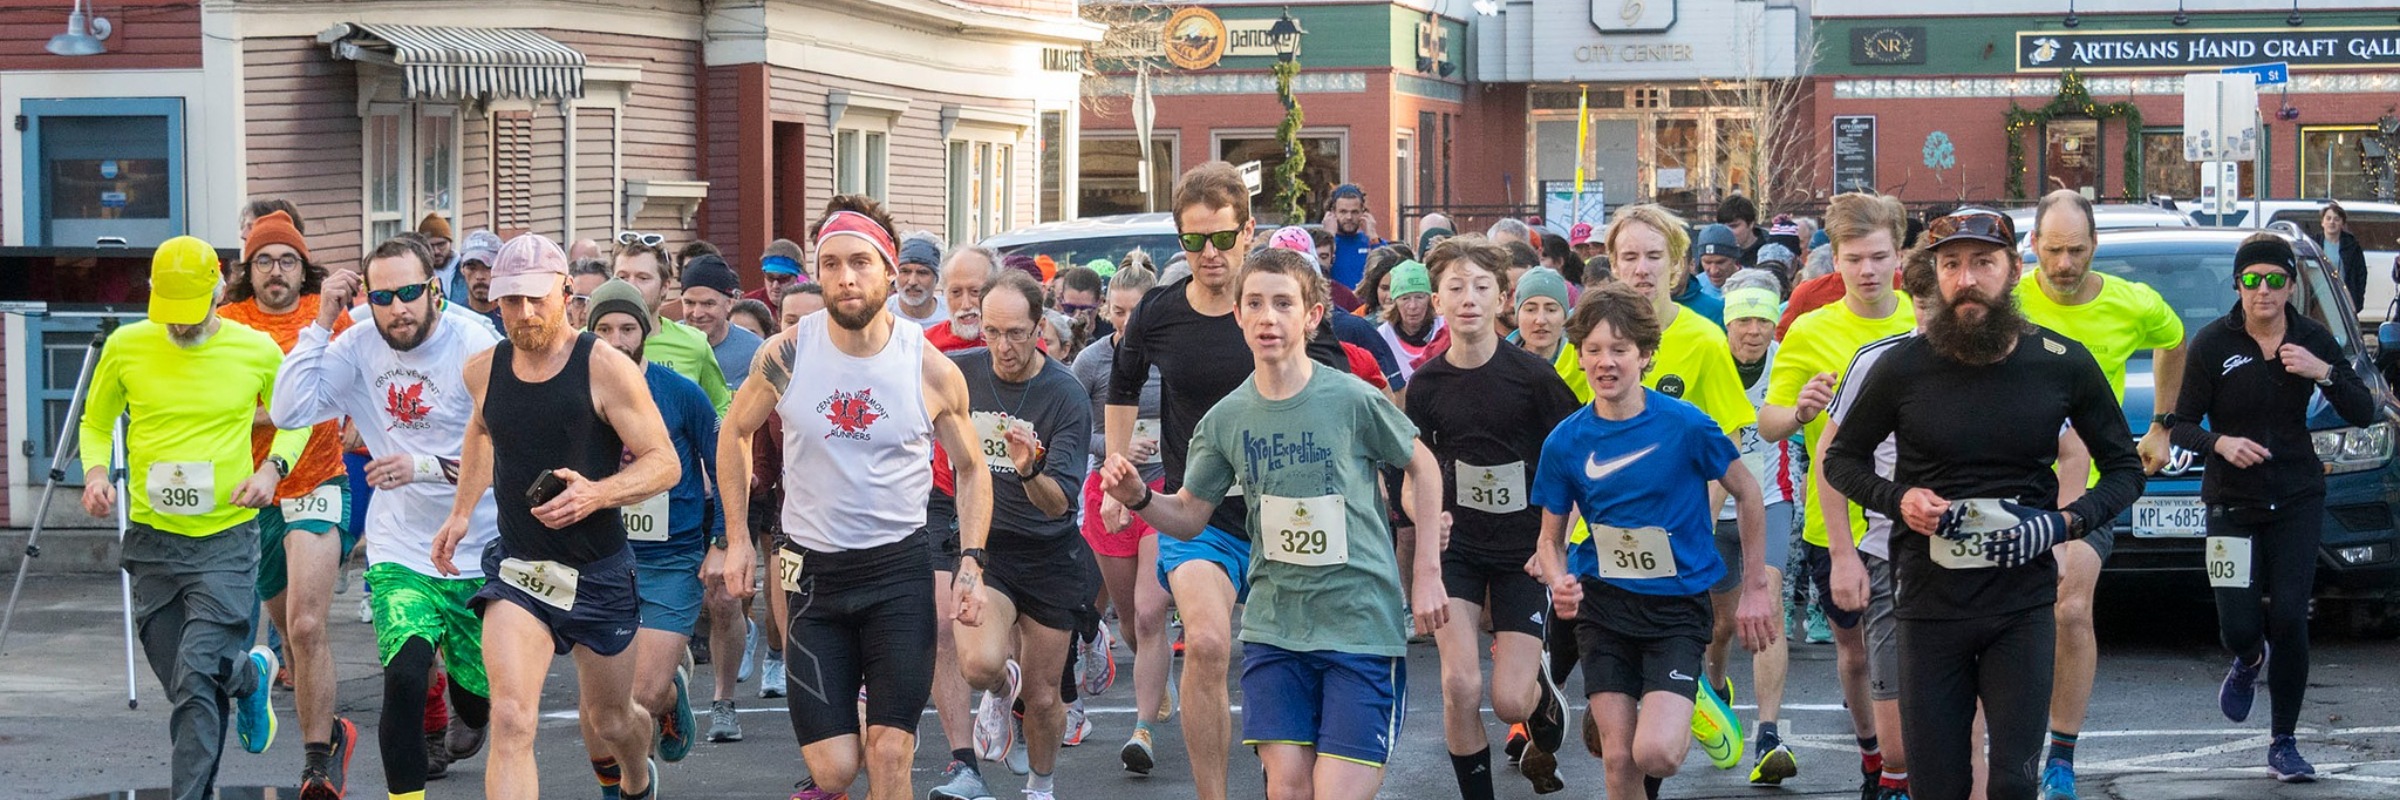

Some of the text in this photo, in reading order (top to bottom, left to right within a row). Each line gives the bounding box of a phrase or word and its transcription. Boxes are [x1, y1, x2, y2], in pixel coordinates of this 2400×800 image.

[1575, 44, 1693, 62] CITY CENTER
[1877, 38, 1901, 52] NR
[2071, 41, 2179, 64] ARTISANS
[2187, 38, 2256, 62] HAND
[2263, 39, 2338, 58] CRAFT
[2268, 69, 2279, 81] St
[1662, 384, 1679, 393] CSC
[830, 428, 871, 441] RUNNERS
[983, 438, 1012, 458] 33
[161, 487, 200, 507] 396
[294, 496, 329, 513] 379
[1471, 486, 1511, 506] 313
[2140, 507, 2164, 527] KPL
[1280, 529, 1328, 555] 329
[1950, 532, 1992, 557] 33
[1613, 549, 1657, 571] 316
[516, 571, 557, 597] 391
